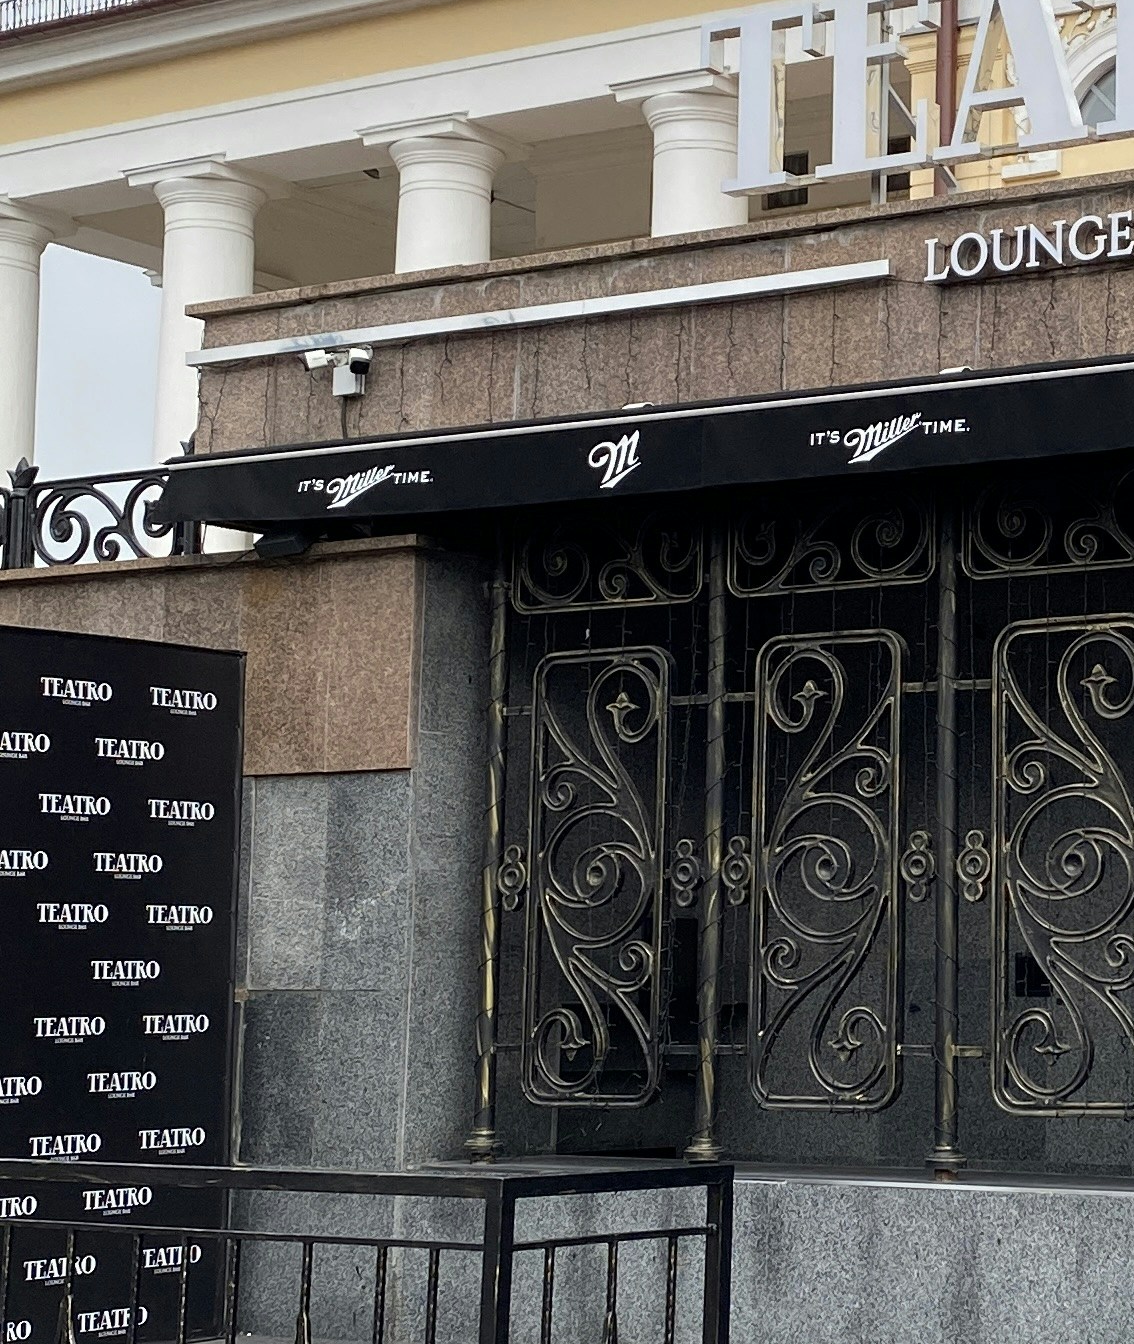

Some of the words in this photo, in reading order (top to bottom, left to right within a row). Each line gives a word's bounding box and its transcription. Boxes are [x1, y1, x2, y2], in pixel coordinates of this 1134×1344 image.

[810, 430, 840, 446] IT'S
[844, 412, 922, 464] Miller
[920, 419, 971, 435] TIME.
[297, 479, 324, 493] IT'S
[326, 464, 396, 509] Miller
[41, 677, 112, 701] TEATRO
[150, 687, 217, 710] TEATRO
[95, 738, 164, 760] TEATRO
[39, 794, 110, 815] TEATRO
[148, 799, 214, 820] TEATRO
[94, 853, 162, 872] TEATRO
[37, 903, 108, 922] TEATRO
[146, 905, 213, 924] TEATRO
[91, 961, 160, 979] TEATRO
[34, 1017, 105, 1037] TEATRO
[143, 1015, 209, 1034] TEATRO
[87, 1071, 156, 1092] TEATRO
[29, 1134, 101, 1156] TEATRO
[139, 1128, 205, 1149] TEATRO
[83, 1187, 152, 1210] TEATRO
